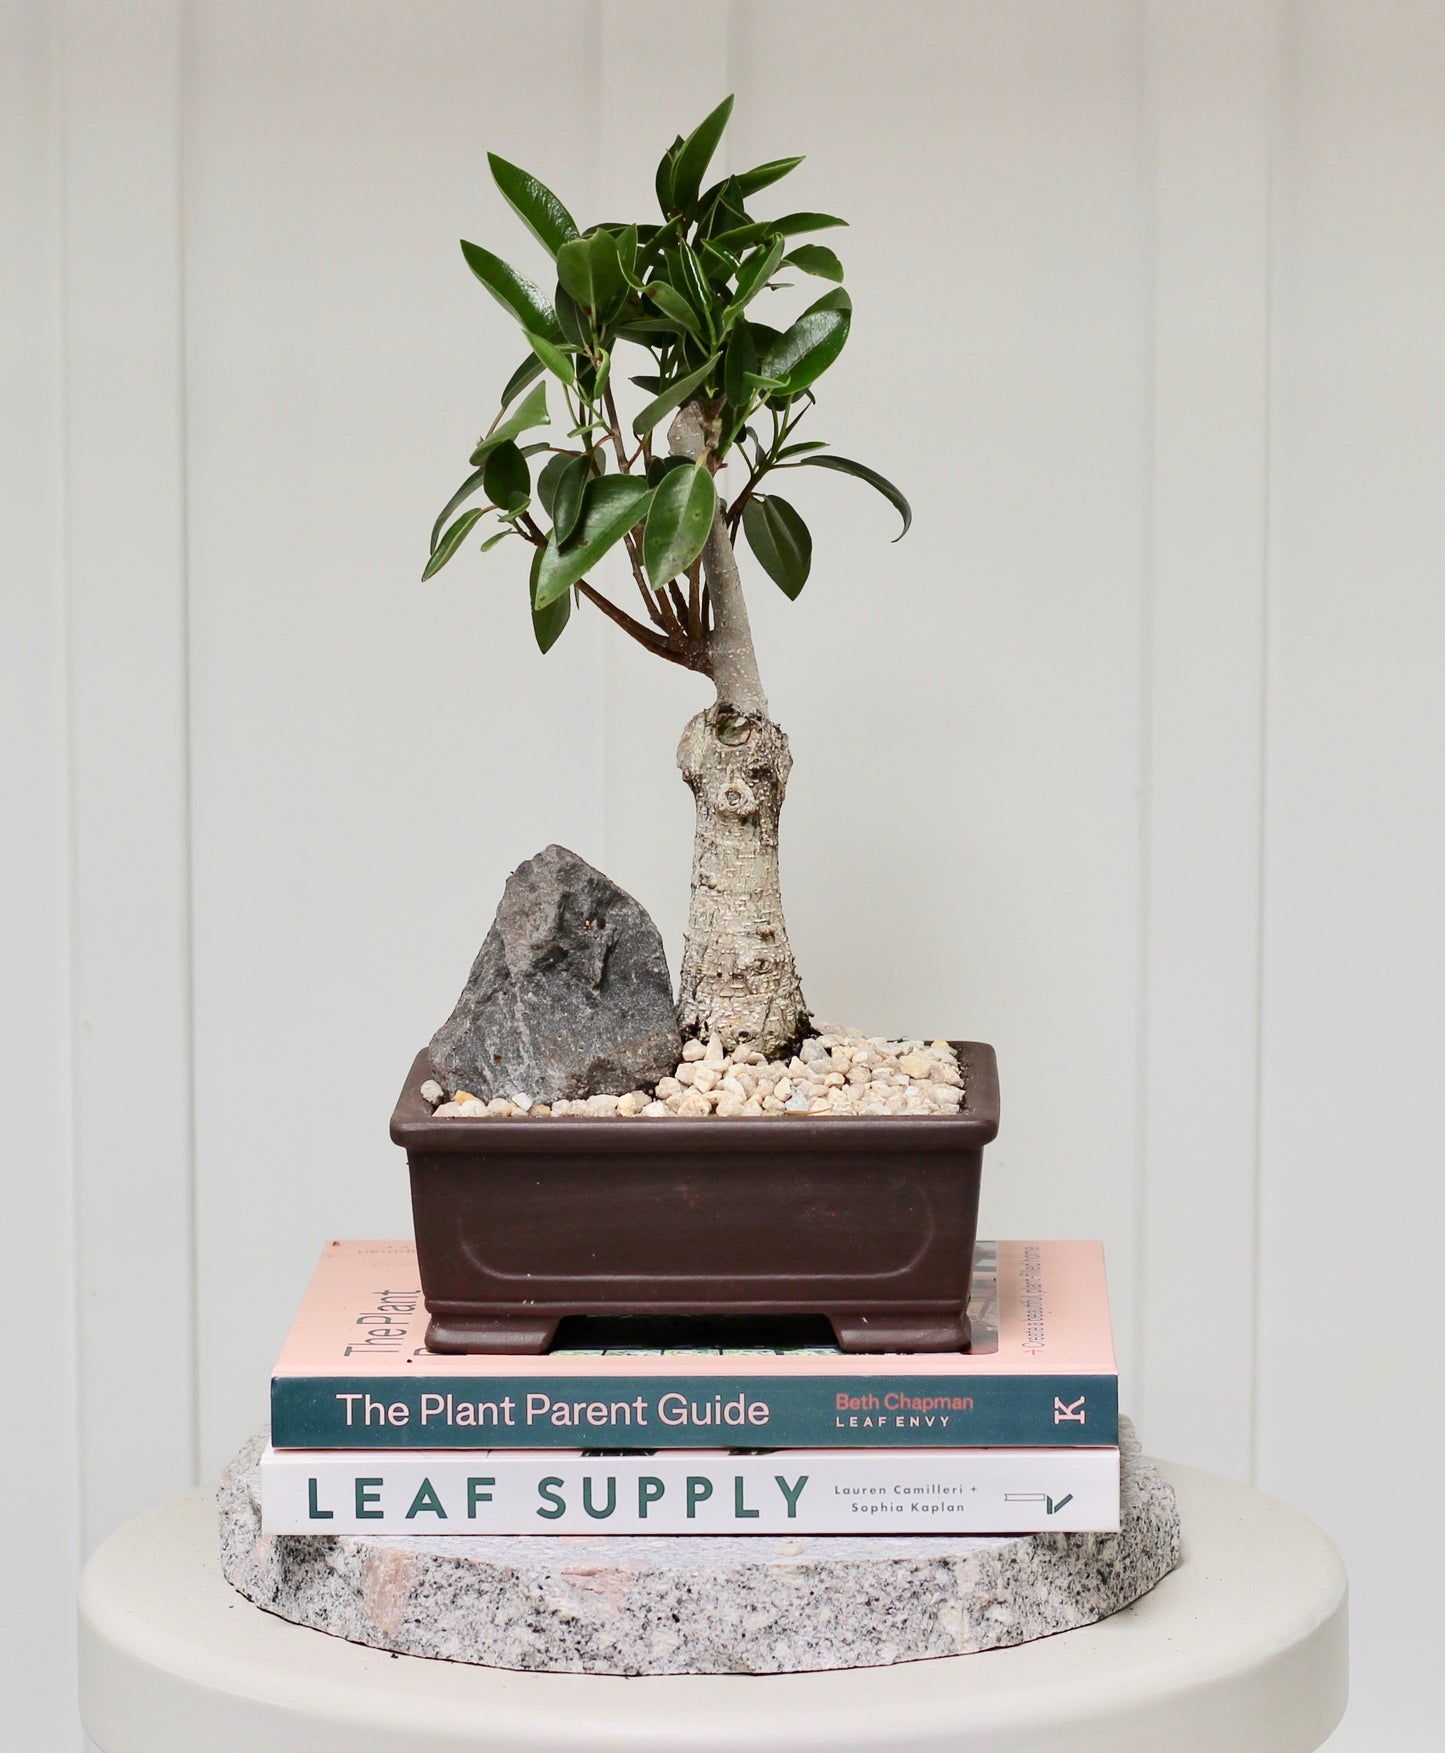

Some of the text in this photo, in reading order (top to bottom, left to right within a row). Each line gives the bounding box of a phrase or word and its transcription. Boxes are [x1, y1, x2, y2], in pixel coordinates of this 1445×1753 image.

[356, 1290, 421, 1325] Plant
[344, 1329, 407, 1356] The
[336, 1392, 770, 1426] The Plant Parent Guide
[836, 1392, 974, 1413] Beth Chapman
[1054, 1395, 1086, 1425] K
[836, 1416, 949, 1427] LEAF ENVY
[308, 1475, 809, 1520] LEAF SUPPLY
[835, 1485, 887, 1495] Lauren
[893, 1484, 963, 1495] Camilleri
[852, 1502, 965, 1515] Sophia Kaplan
